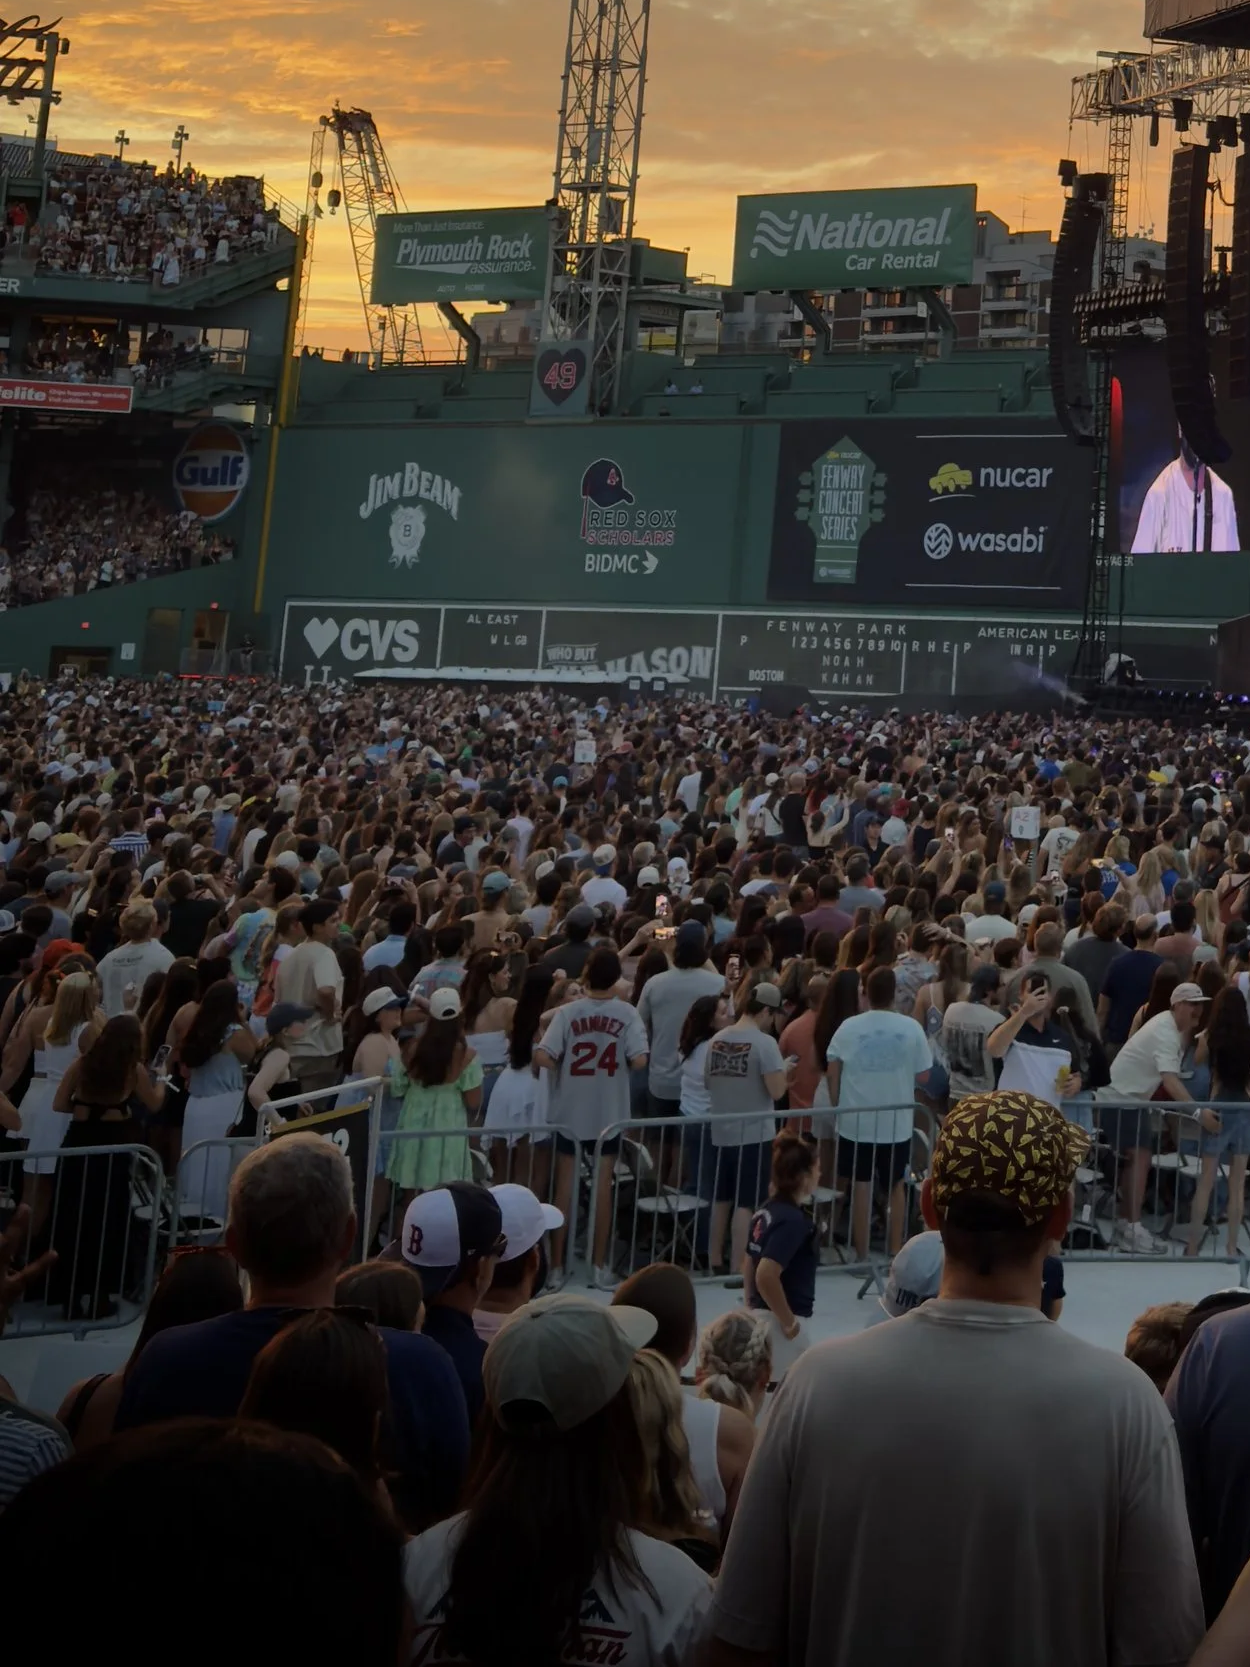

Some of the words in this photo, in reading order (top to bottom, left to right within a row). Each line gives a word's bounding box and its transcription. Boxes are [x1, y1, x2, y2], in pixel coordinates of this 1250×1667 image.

[793, 207, 951, 251] National
[396, 236, 484, 267] Plymouth
[486, 233, 533, 260] Rock
[845, 254, 875, 271] Car
[881, 251, 940, 270] Rental
[543, 362, 577, 389] 49
[175, 455, 244, 486] Gulf
[820, 464, 865, 490] FENWAY
[980, 467, 1053, 488] nucar
[359, 472, 402, 520] JIM
[402, 461, 460, 520] BEAM
[818, 490, 864, 515] CONCERT
[589, 509, 628, 527] RED
[635, 509, 677, 527] SOX
[820, 516, 858, 541] SERIES
[586, 529, 675, 545] SCHOLARS
[958, 525, 1045, 553] wasabi
[584, 554, 640, 573] BIDMC
[467, 614, 481, 624] AL
[487, 614, 518, 624] EAST
[766, 620, 843, 634] FENWAY
[857, 624, 906, 635] PARK
[340, 618, 419, 662] CVS
[503, 635, 510, 645] L
[978, 627, 1048, 639] AMERICAN
[1055, 630, 1106, 642] LEAE
[546, 647, 572, 661] WHO
[574, 647, 597, 661] BUT
[740, 635, 748, 646] P
[791, 636, 796, 648] 1
[800, 636, 807, 648] 2
[809, 636, 818, 648] 3
[823, 637, 831, 649] 4
[834, 637, 841, 650] 5
[844, 638, 851, 650] 6
[857, 638, 864, 650] 7
[867, 639, 875, 651] 8
[878, 639, 885, 651] 9
[890, 640, 901, 652] 10
[911, 640, 919, 652] R
[928, 640, 936, 653] H
[943, 641, 950, 653] E
[964, 642, 972, 654] P
[1026, 644, 1034, 656] R
[1049, 645, 1057, 656] P
[822, 655, 864, 667] NOAH
[748, 670, 784, 682] BOSTON
[821, 673, 874, 685] KAHAN
[571, 1015, 624, 1038] RAMIREZ
[570, 1042, 619, 1077] 24
[407, 1224, 424, 1255] B
